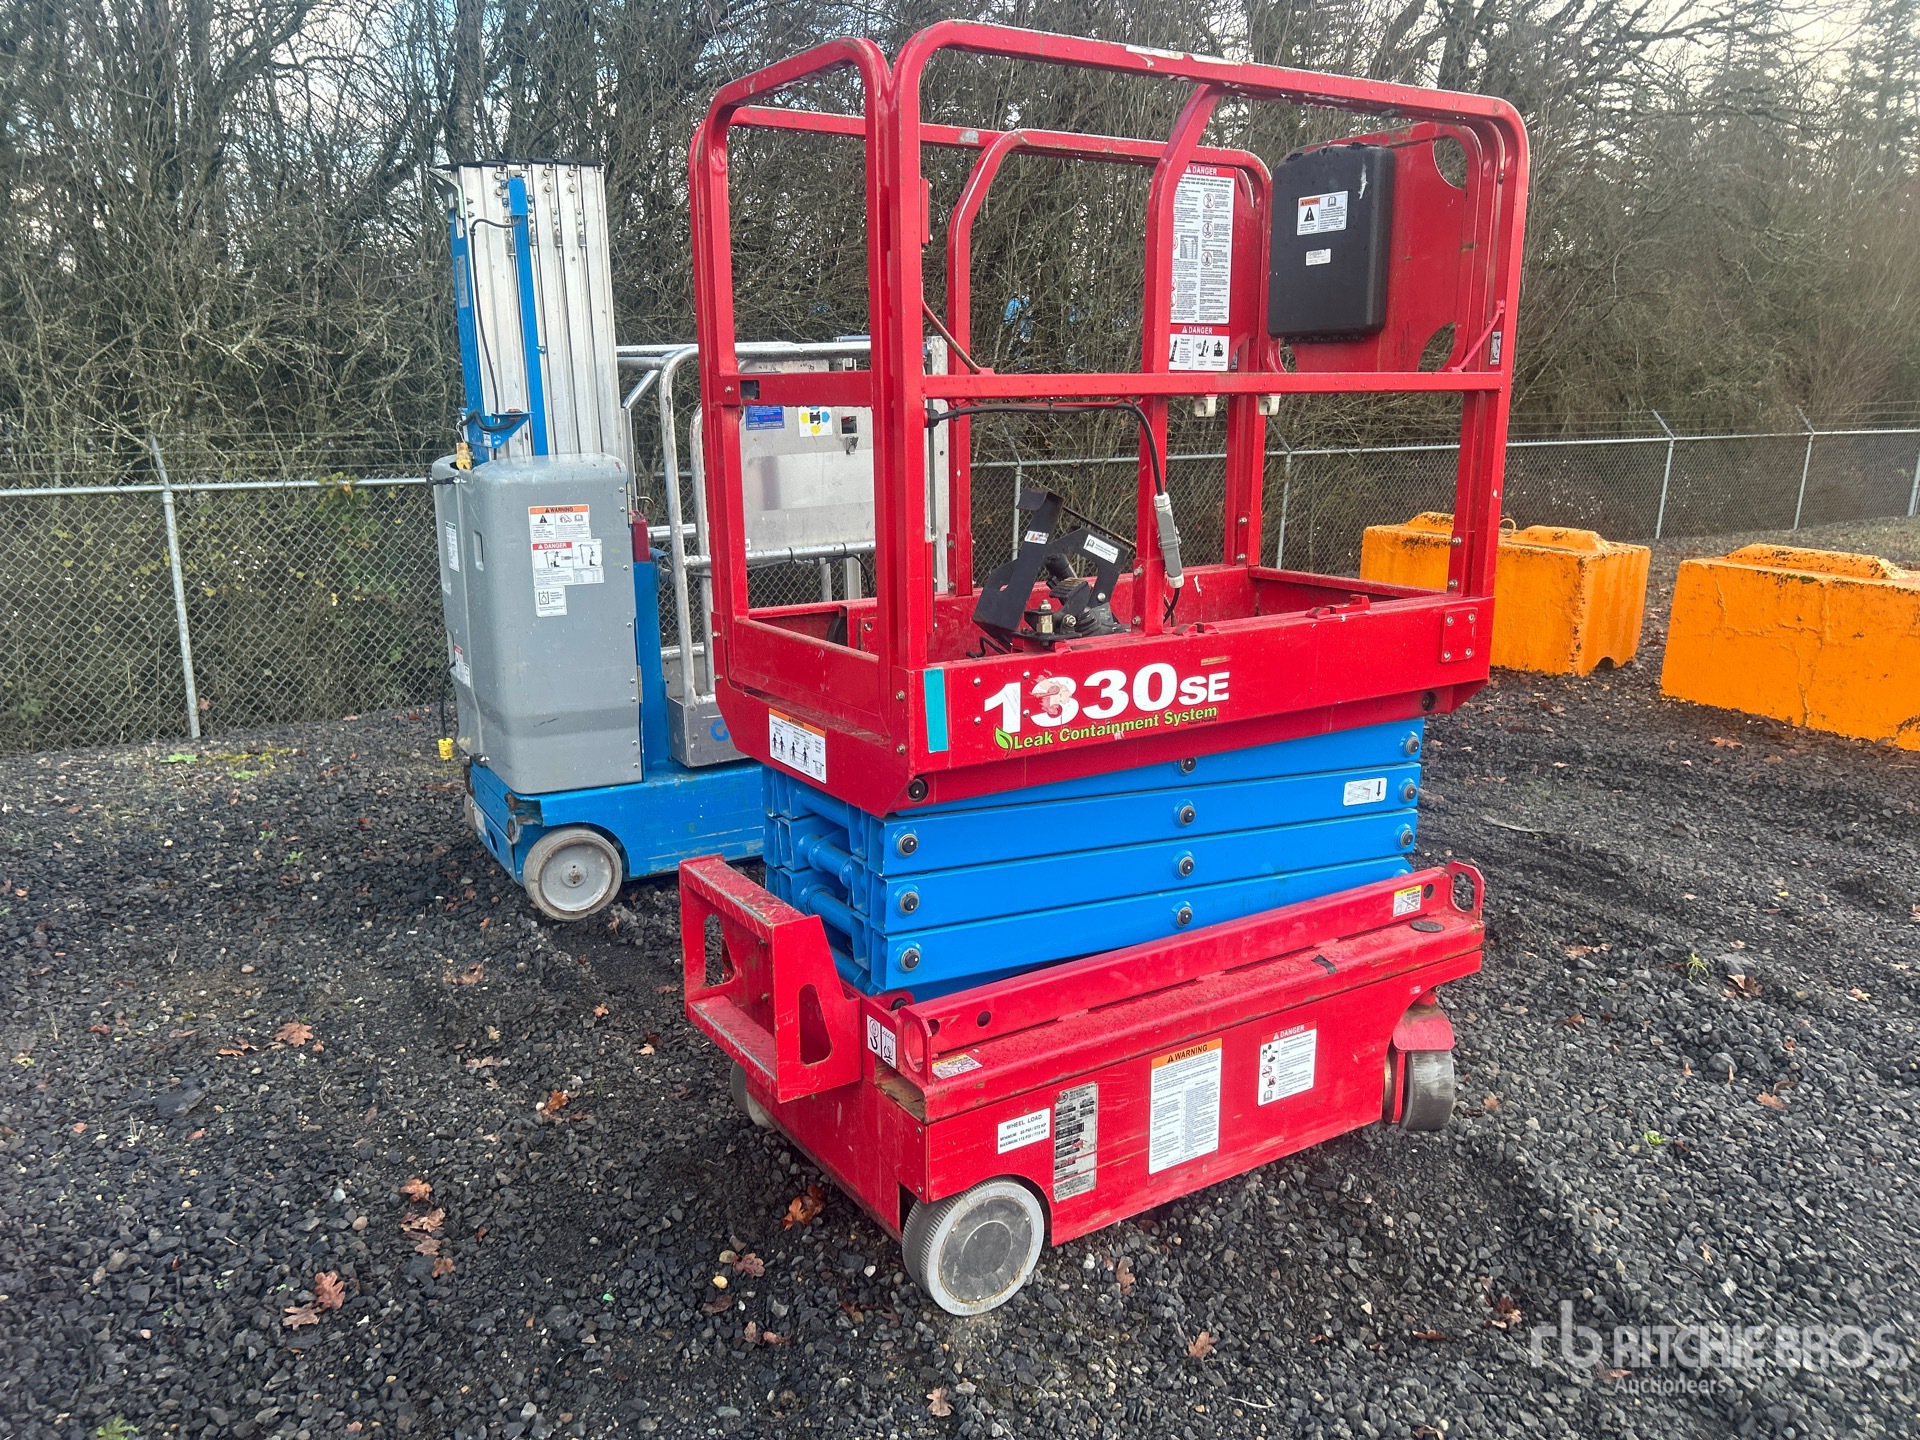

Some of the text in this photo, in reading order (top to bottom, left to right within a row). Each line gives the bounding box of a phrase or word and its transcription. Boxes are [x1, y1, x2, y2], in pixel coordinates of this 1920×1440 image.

[1192, 165, 1218, 176] DANGER
[1188, 326, 1212, 334] DANGER
[1013, 706, 1218, 750] Leak Containment System
[1280, 1024, 1304, 1038] DANGER
[1174, 1044, 1208, 1061] WARNING
[1006, 1114, 1042, 1130] WHEEL LOAD
[1000, 1139, 1017, 1148] MAXIMUM
